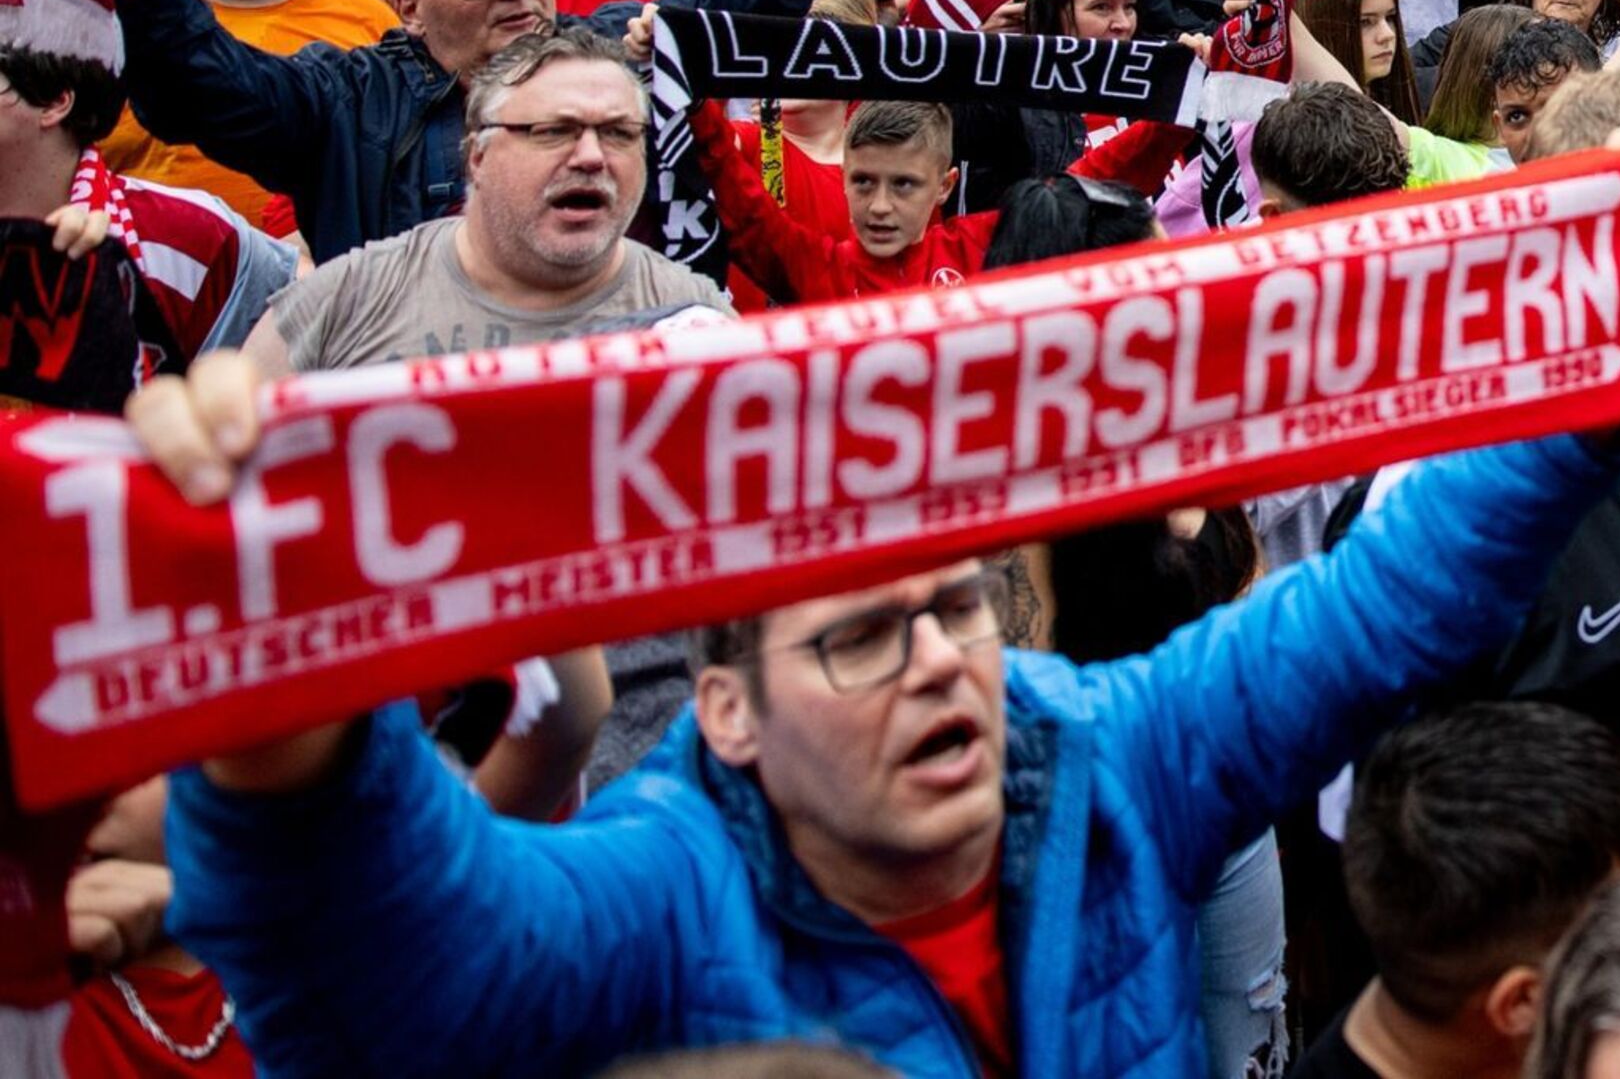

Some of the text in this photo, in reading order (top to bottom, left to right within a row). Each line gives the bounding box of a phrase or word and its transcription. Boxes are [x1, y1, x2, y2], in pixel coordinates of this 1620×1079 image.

[698, 10, 1168, 100] LAUTRE
[44, 460, 222, 668] 1.
[230, 401, 465, 624] FC
[97, 584, 438, 717] DEUTSCHER
[491, 530, 714, 618] MEISTER
